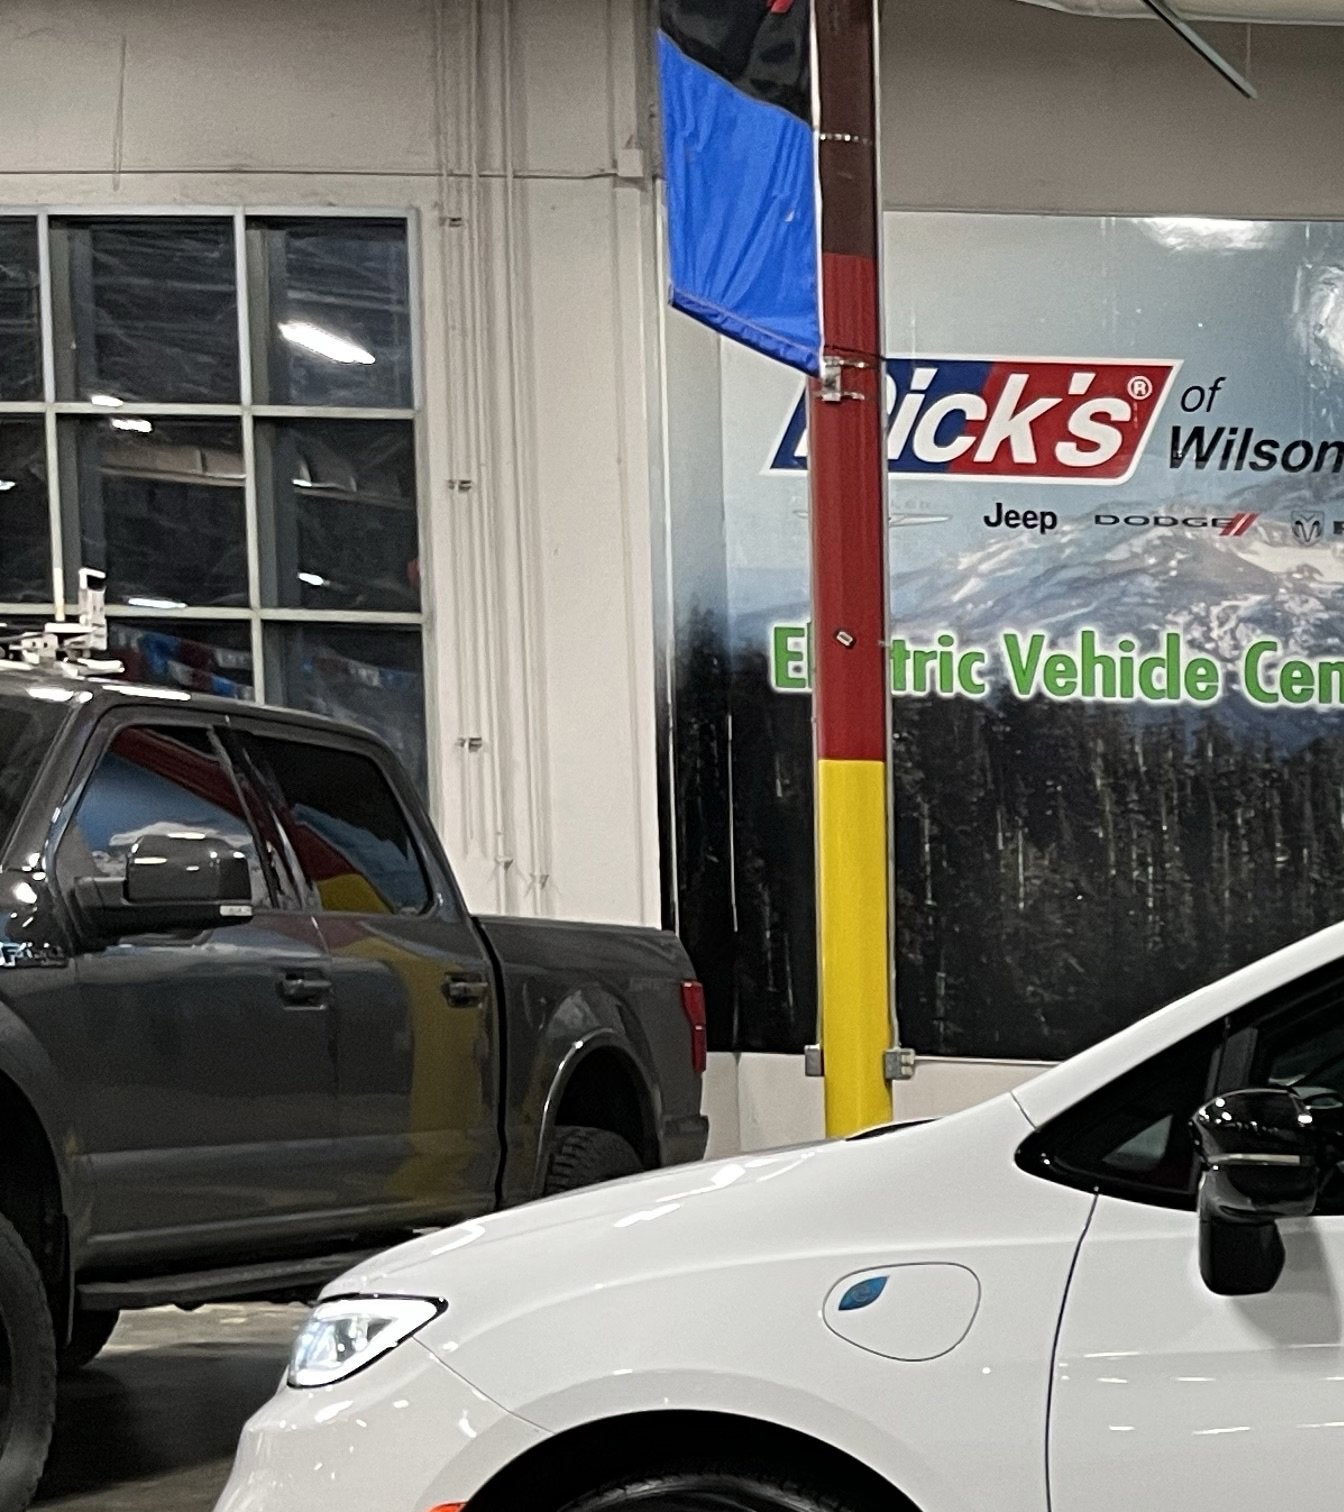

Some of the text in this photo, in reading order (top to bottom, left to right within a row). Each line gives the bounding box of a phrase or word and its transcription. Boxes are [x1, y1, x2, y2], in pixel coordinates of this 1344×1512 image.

[1180, 376, 1227, 412] of
[983, 502, 1058, 535] Jeep
[1094, 514, 1233, 528] DODGE
[773, 620, 986, 695] Etric
[1003, 630, 1219, 700] Vehicle
